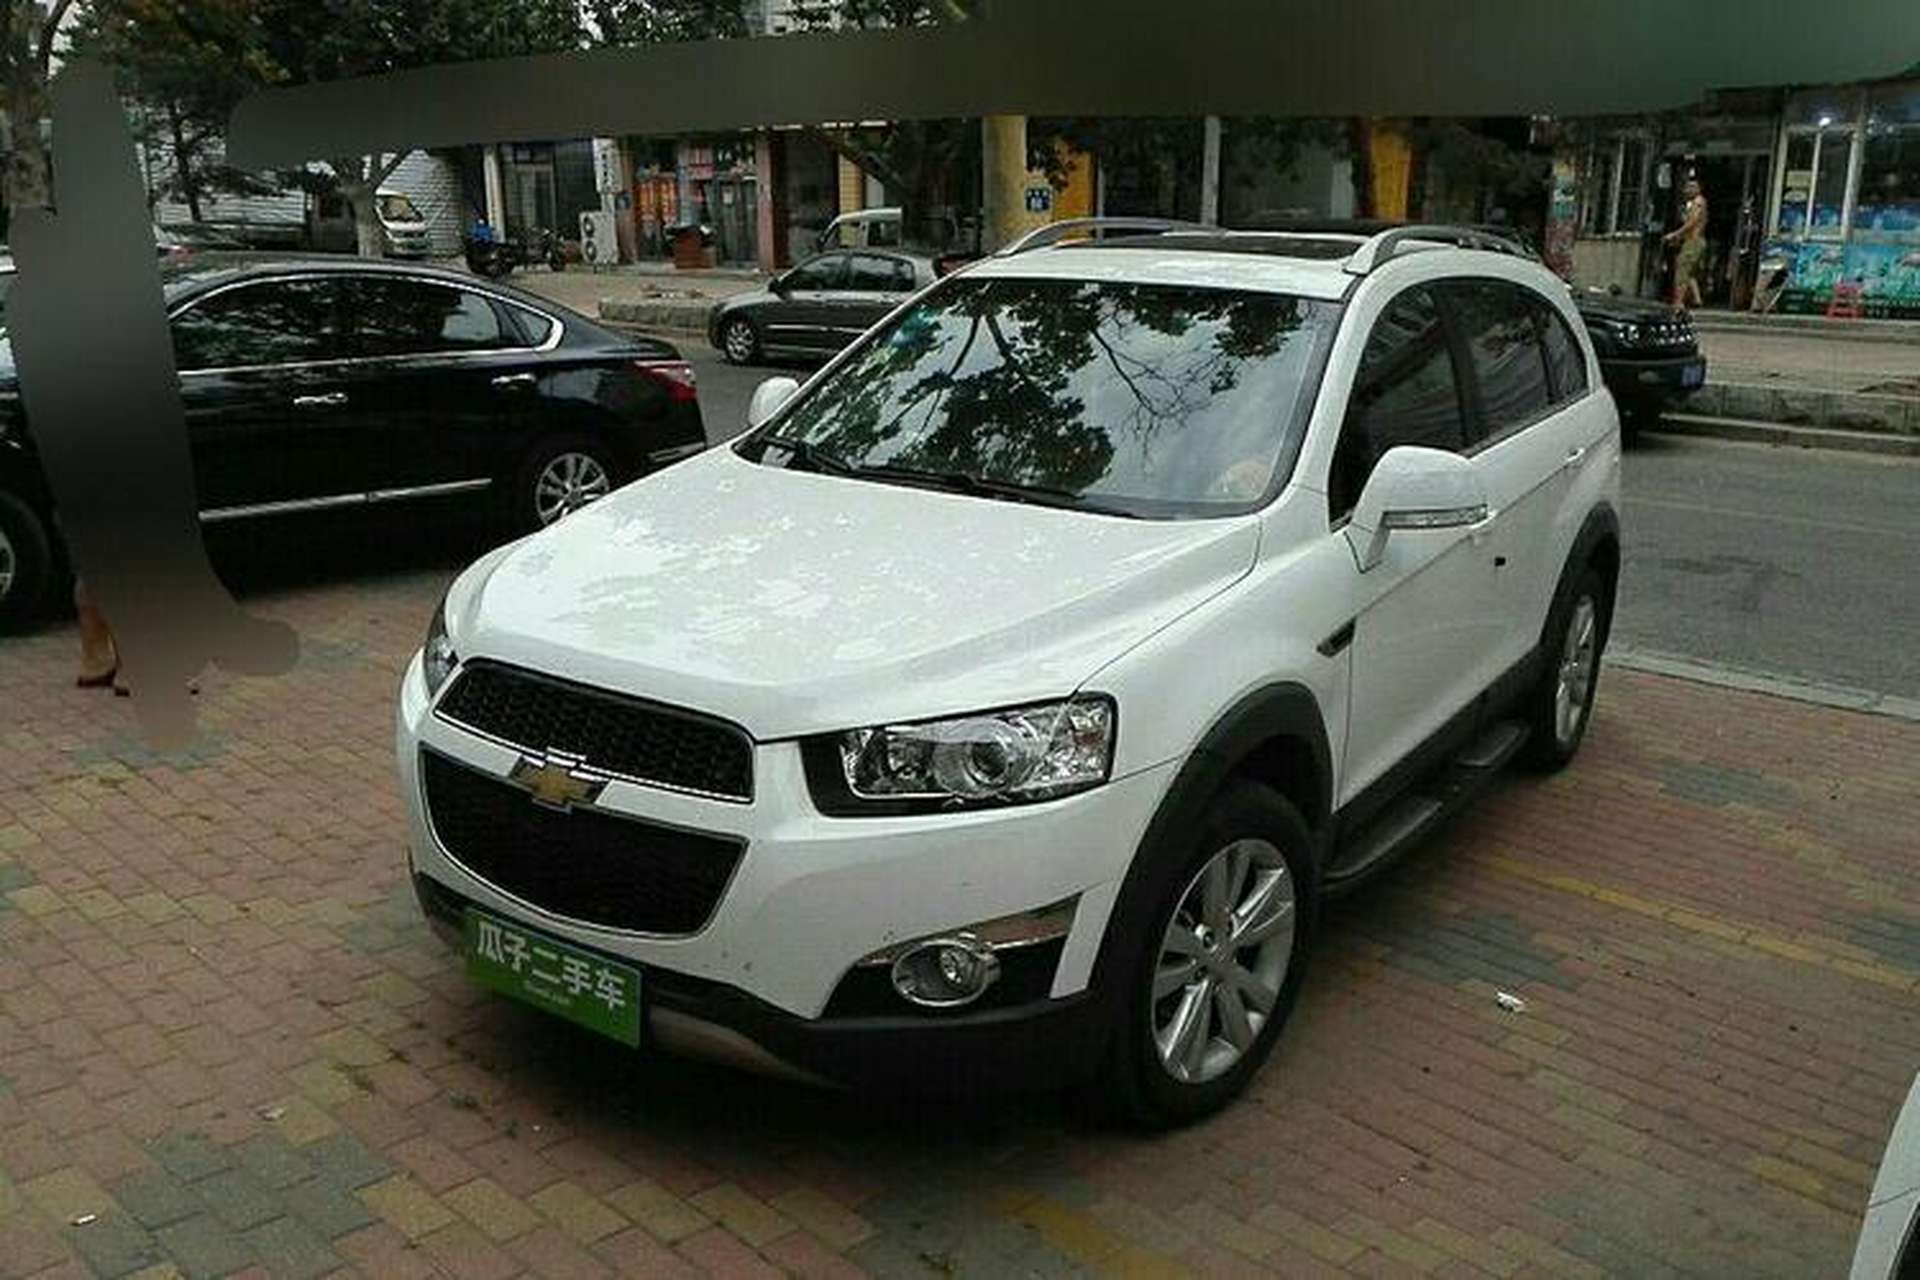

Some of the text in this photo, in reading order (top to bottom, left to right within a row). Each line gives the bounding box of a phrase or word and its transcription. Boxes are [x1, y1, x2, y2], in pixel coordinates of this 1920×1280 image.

[477, 920, 626, 1010] 瓜子二手车
